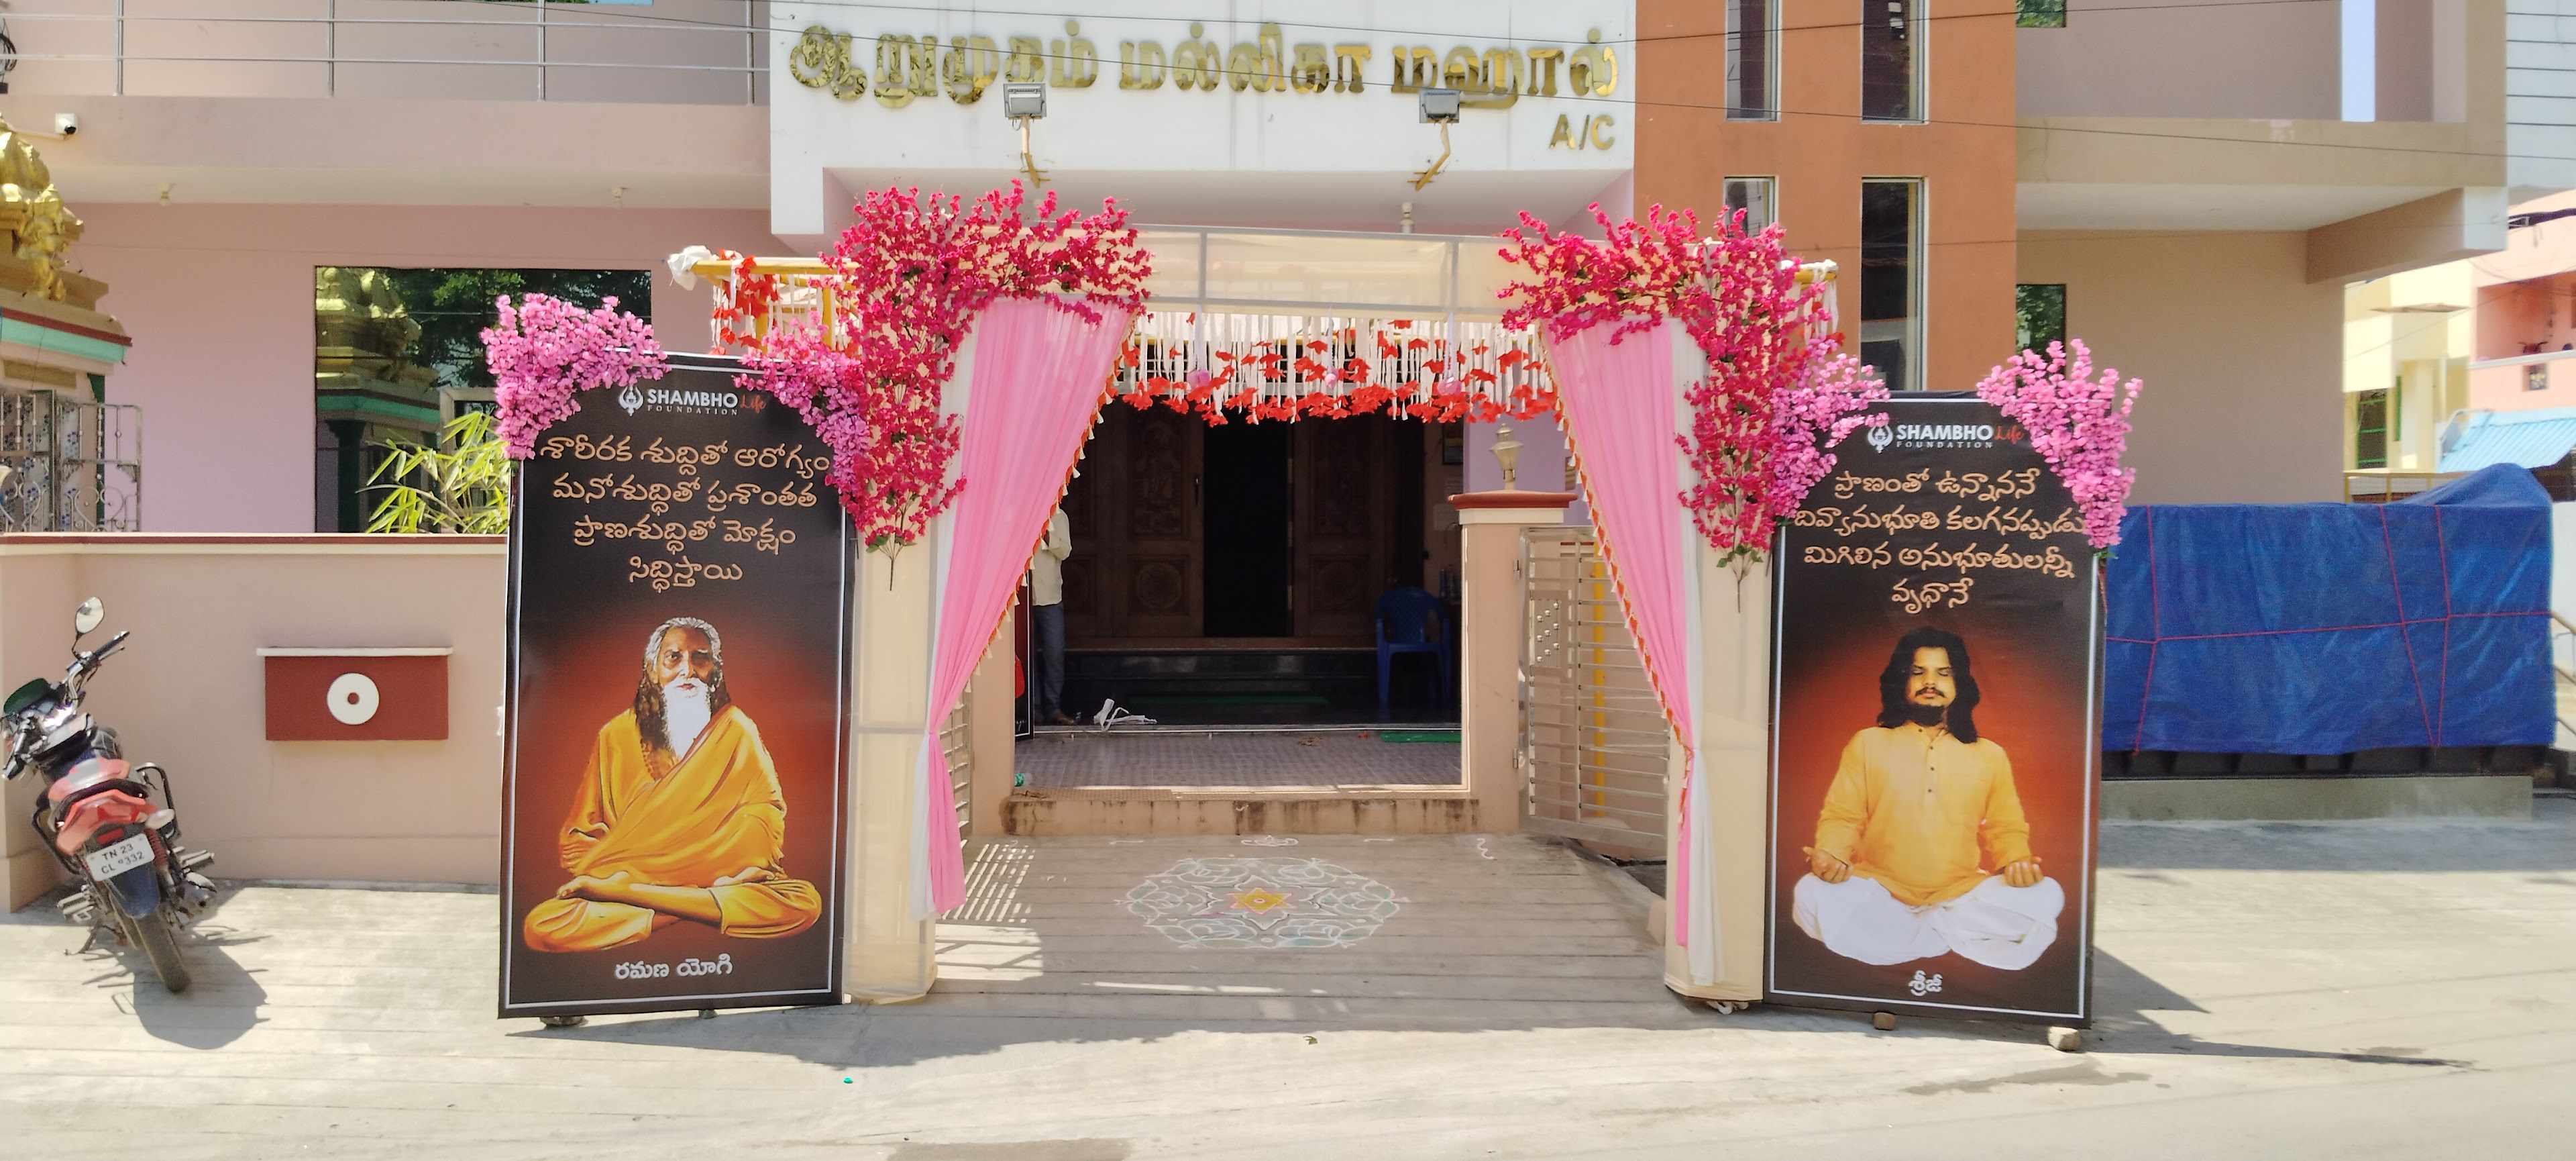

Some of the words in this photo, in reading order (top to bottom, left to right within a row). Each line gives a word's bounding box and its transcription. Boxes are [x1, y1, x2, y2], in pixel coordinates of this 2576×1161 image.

[790, 20, 1099, 109] ஆறுமுகம்
[1119, 22, 1372, 93] மல்லிகா
[1391, 28, 1618, 109] மஹால்
[1548, 113, 1615, 150] A/C
[647, 388, 738, 408] SHAMBHO
[740, 394, 767, 414] Life
[647, 404, 738, 416] FOUNDATION
[1896, 424, 1994, 441] SHAMBHO
[1994, 424, 2024, 444] Life
[1896, 441, 1994, 449] FOUNDATION
[539, 434, 633, 462] శారీరక
[735, 443, 830, 480] ఆరోగ్యం
[552, 471, 701, 516] మనోశుద్ధితో
[706, 480, 818, 513] ప్రశాంతత
[1834, 467, 1931, 499] ప్రాణంతో
[1935, 467, 2041, 503] ఉన్నాననే
[574, 514, 716, 555] ప్రాణశుద్ధితో
[722, 517, 797, 555] మోక్షం
[1793, 504, 1940, 537] దివ్యానుభూతి
[1945, 504, 2086, 540] కలగనప్పుడు
[629, 555, 743, 594] సిద్ధిస్తాయి
[1803, 541, 1892, 570] మిగిలిన
[1898, 542, 2075, 578] అనుభూతులన్నీ
[101, 863, 116, 874] CL
[102, 849, 117, 860] TN
[120, 843, 133, 854] 23
[614, 960, 670, 980] రమణ
[676, 952, 733, 976] యోగి
